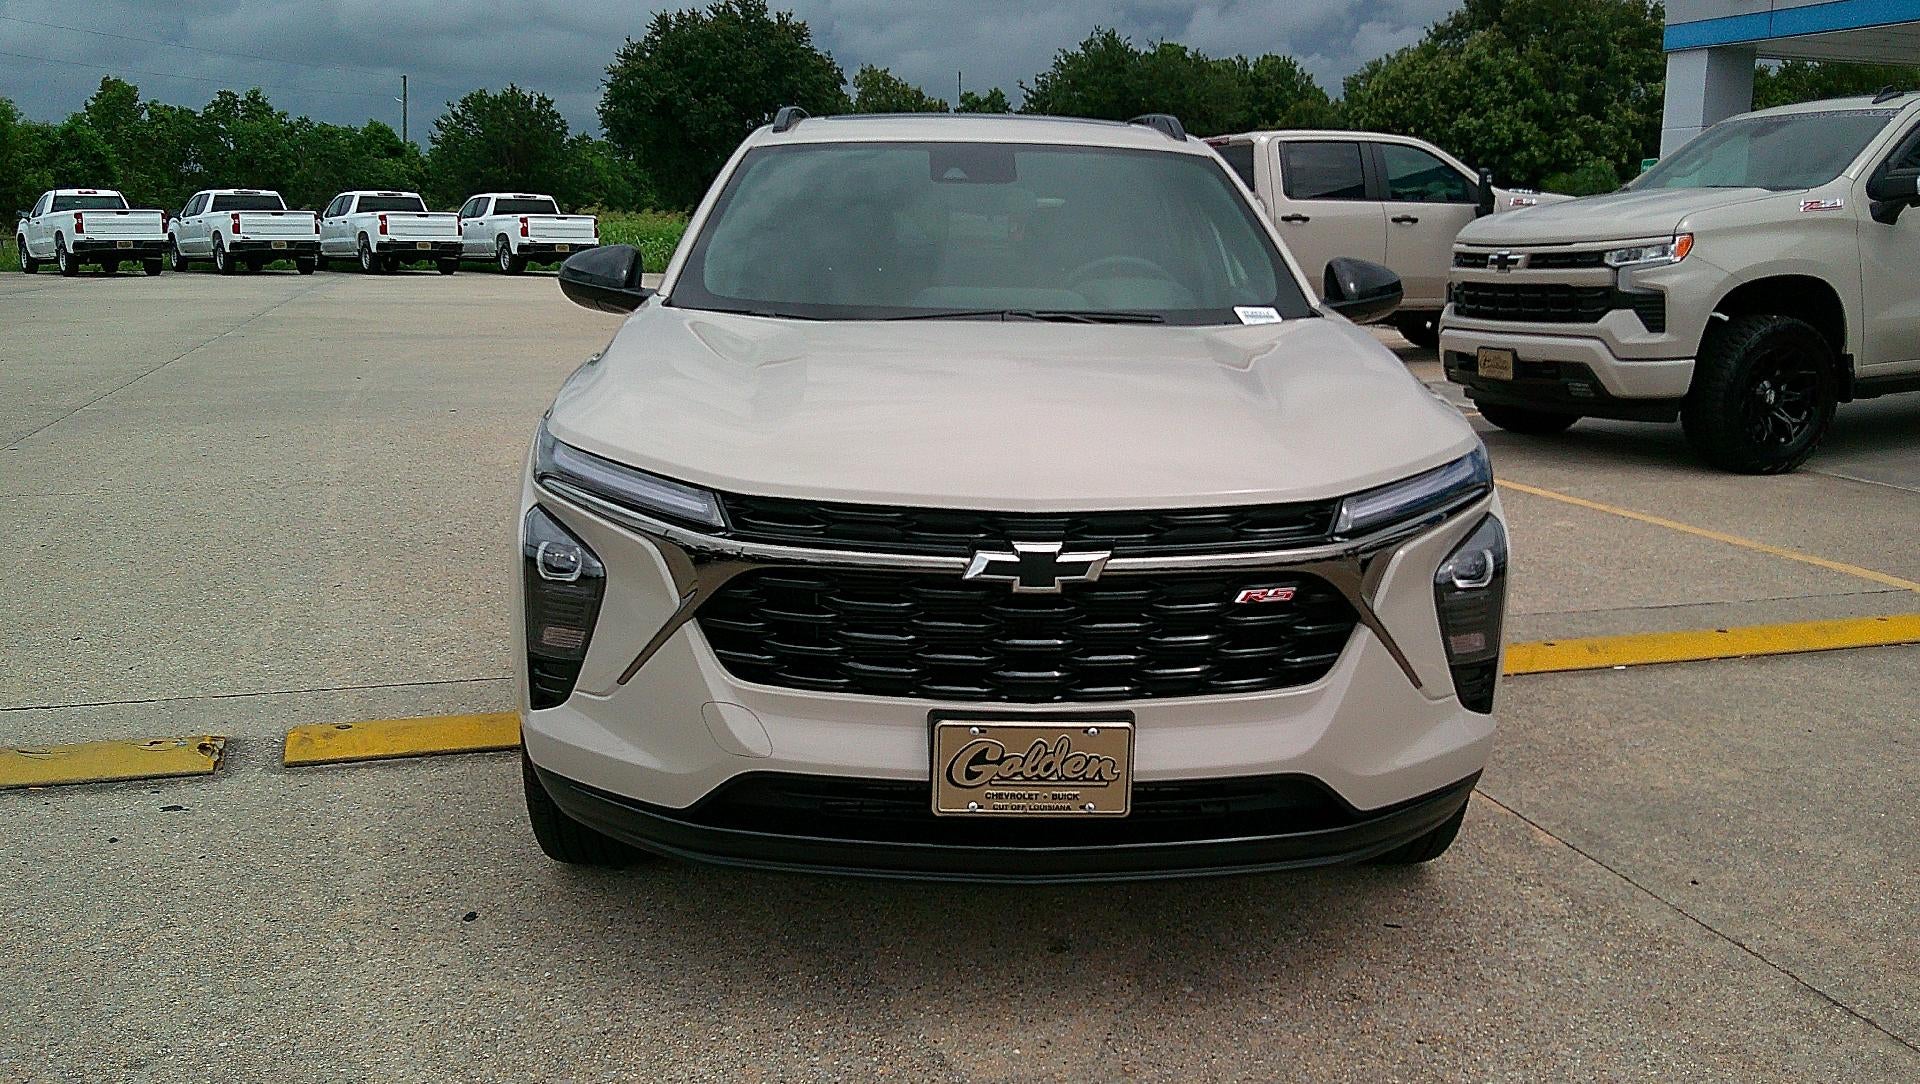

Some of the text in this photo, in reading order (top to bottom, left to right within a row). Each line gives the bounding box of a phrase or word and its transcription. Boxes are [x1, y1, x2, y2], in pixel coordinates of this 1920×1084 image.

[1234, 586, 1297, 603] RS
[945, 734, 1121, 789] Golden
[985, 791, 1080, 801] CHEVROLET BUICK
[993, 802, 1009, 811] CUT
[1028, 802, 1072, 811] LOUISIANA
